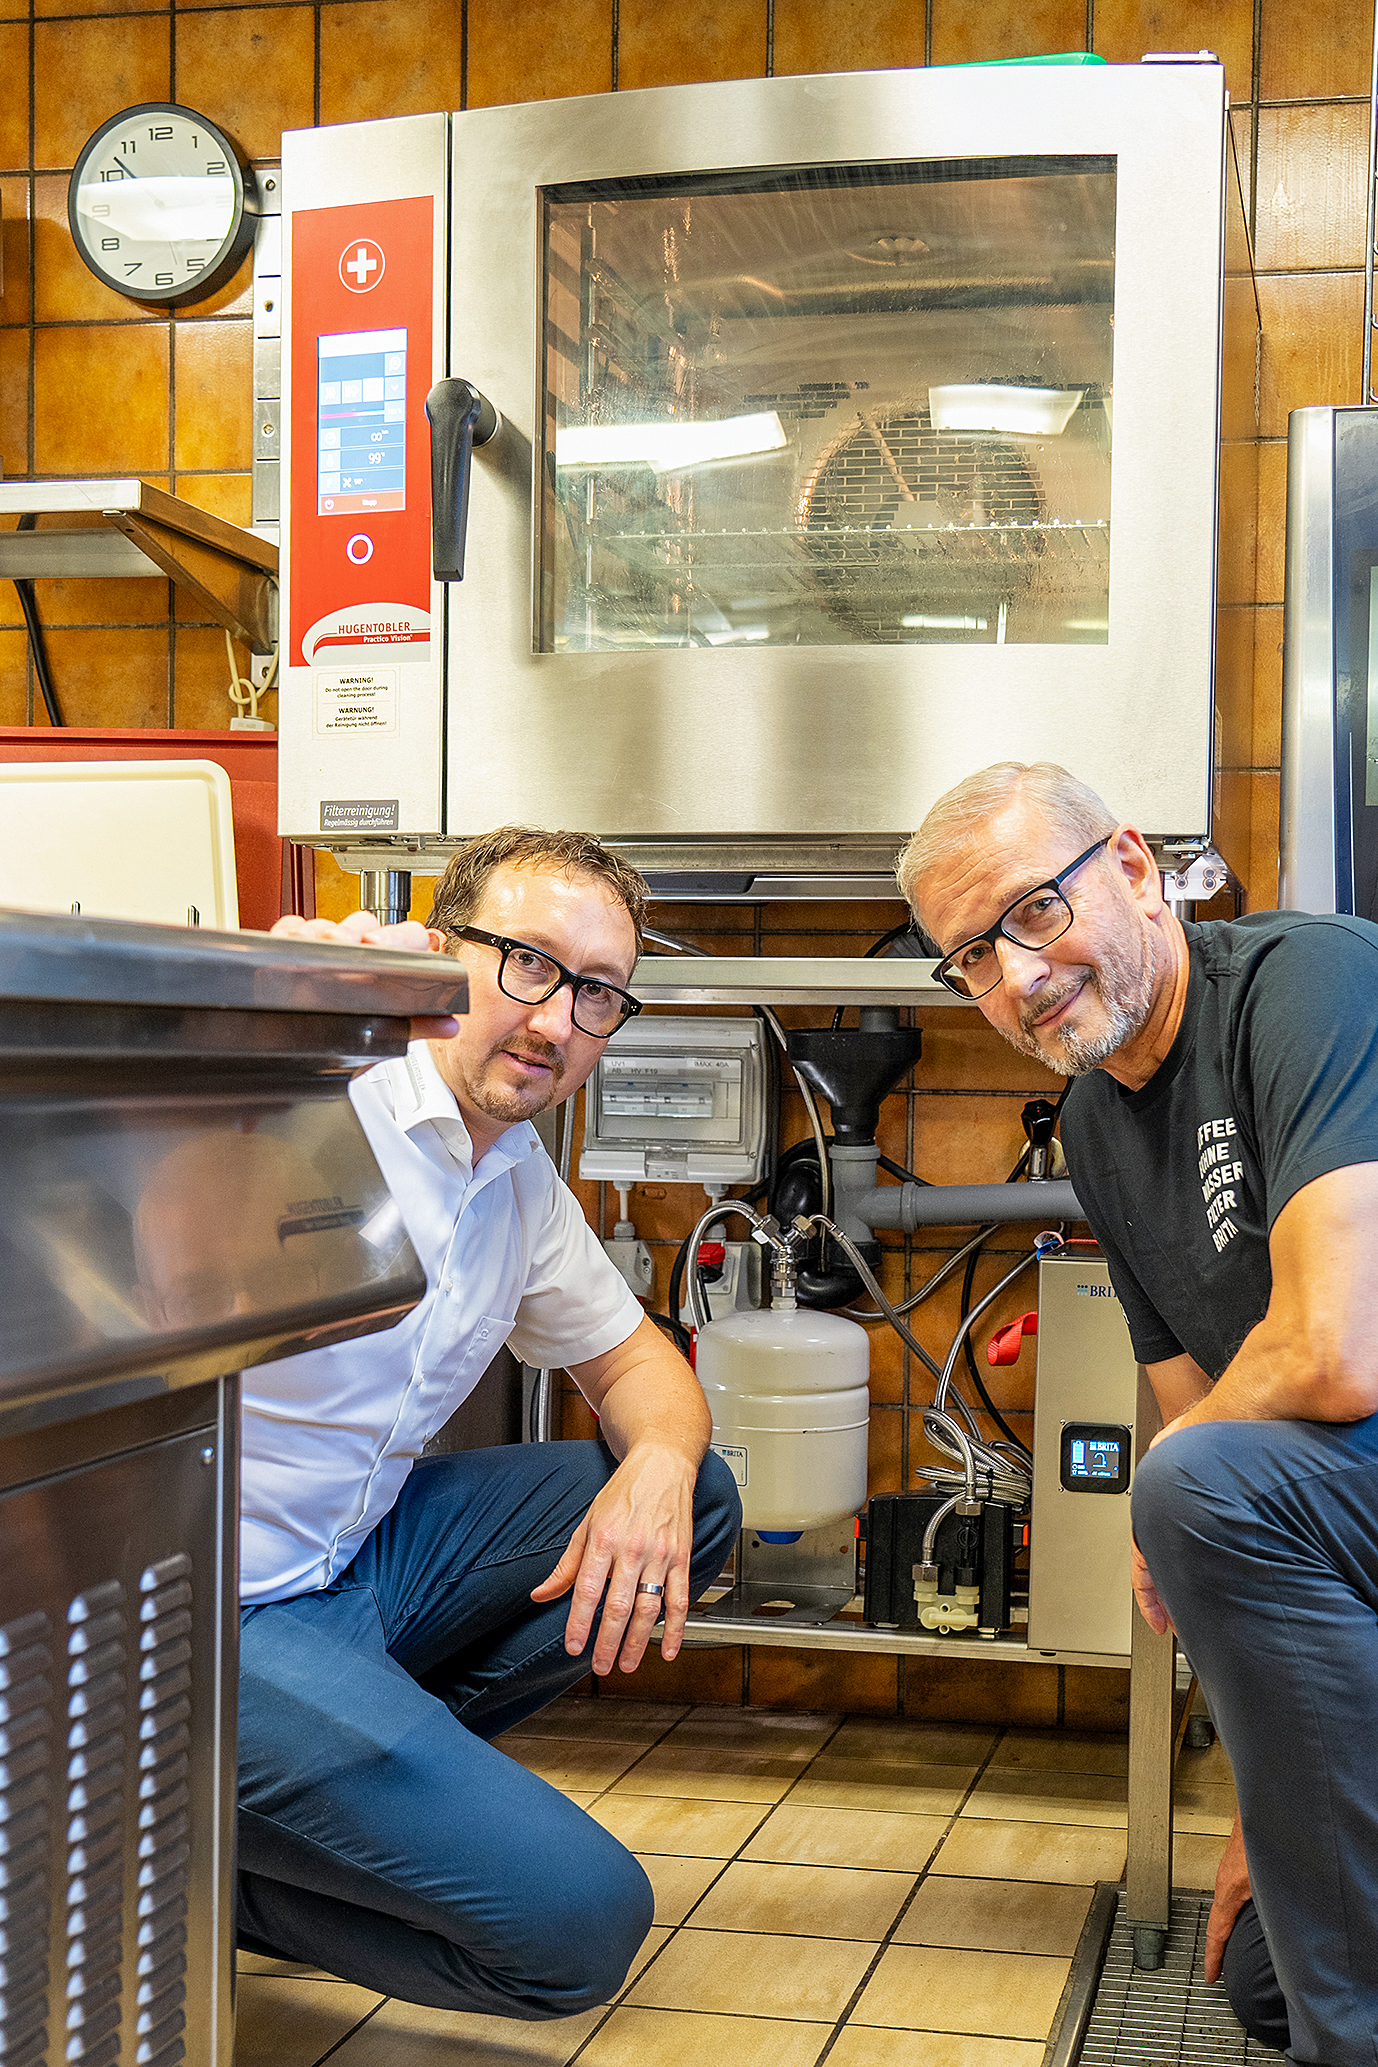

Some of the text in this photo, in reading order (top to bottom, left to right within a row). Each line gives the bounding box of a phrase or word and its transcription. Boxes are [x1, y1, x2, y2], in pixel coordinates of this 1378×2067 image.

[148, 126, 174, 141] 12
[121, 140, 136, 154] 11
[191, 135, 198, 149] 1
[99, 169, 124, 183] 10
[206, 161, 226, 176] 2
[91, 204, 111, 219] 9
[101, 237, 120, 252] 8
[123, 262, 143, 277] 7
[186, 257, 206, 273] 5
[154, 272, 174, 286] 6
[338, 621, 411, 635] HUGENTOBLER
[363, 634, 389, 644] Practico
[338, 706, 375, 714] WARNUNG!
[323, 804, 396, 819] Filterreinigung!
[1201, 1161, 1245, 1204] WASSER
[1206, 1189, 1238, 1229] FILTER
[1211, 1216, 1239, 1253] BRITA
[726, 1449, 744, 1458] BRITA
[1096, 1441, 1119, 1453] BRITA
